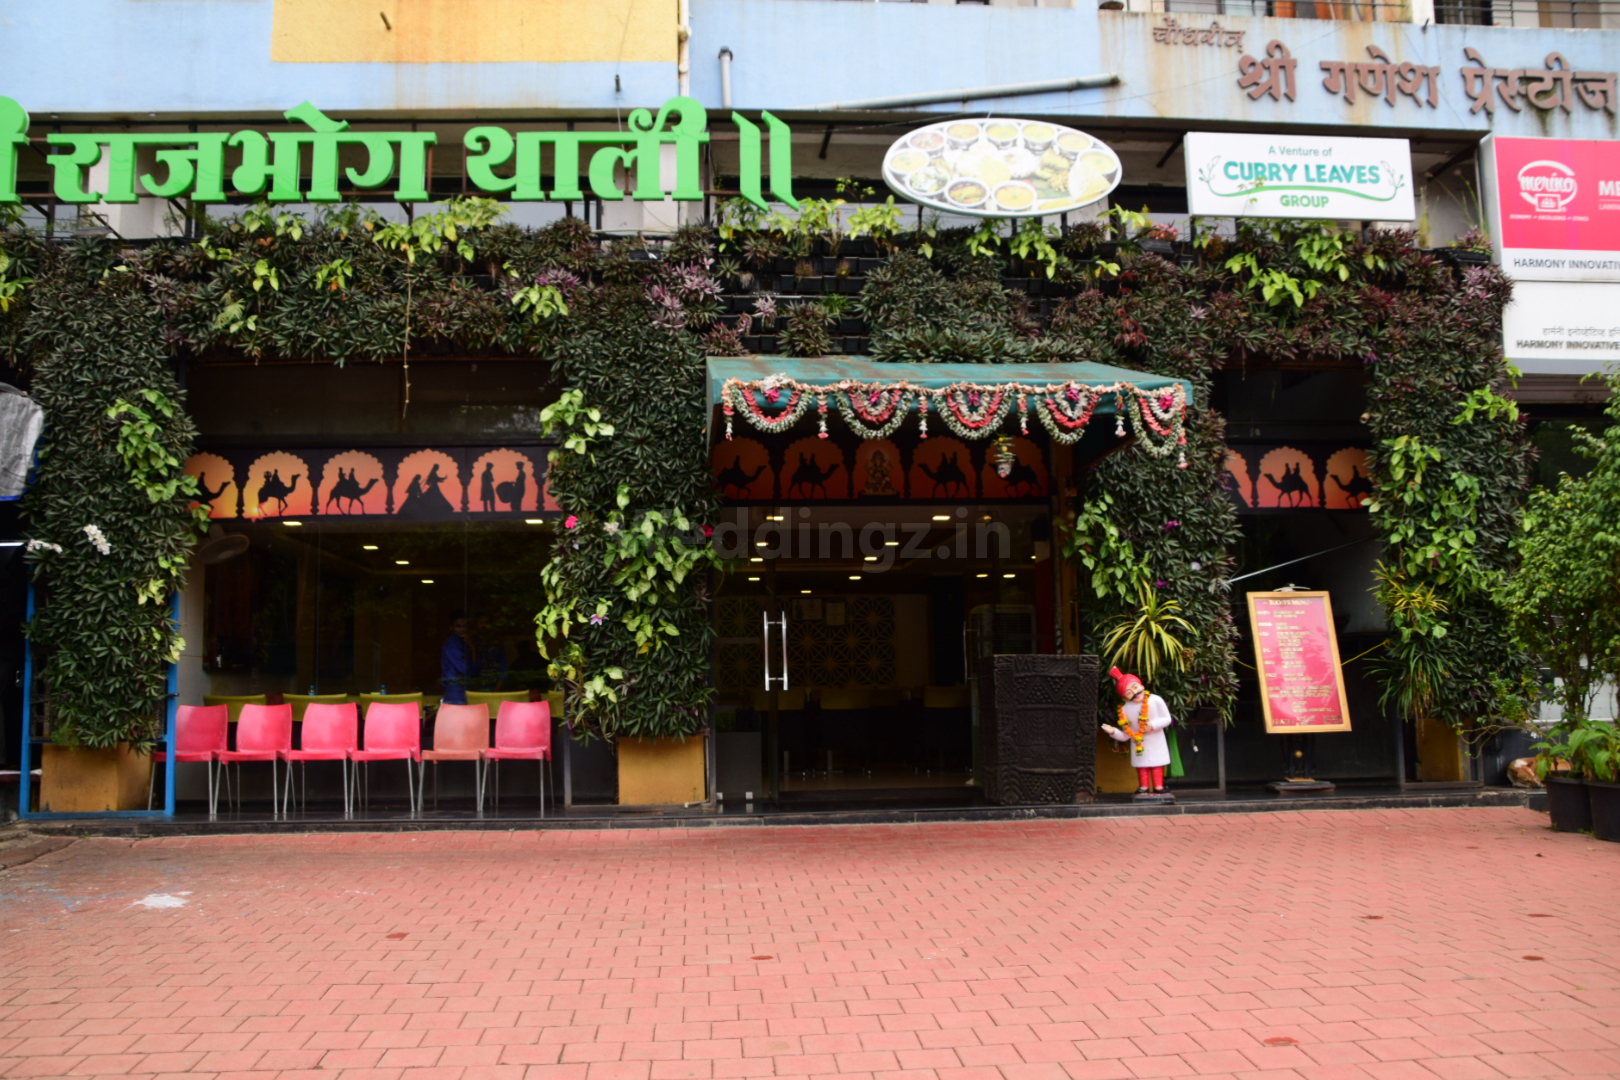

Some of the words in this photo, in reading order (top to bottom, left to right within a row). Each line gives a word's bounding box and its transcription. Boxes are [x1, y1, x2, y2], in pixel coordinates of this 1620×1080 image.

[1237, 39, 1297, 102] श्री
[1320, 45, 1440, 109] गणेश
[1461, 46, 1618, 115] प्रेस्टीज
[46, 100, 438, 203] राजभोग
[463, 95, 710, 201] थाली
[1268, 146, 1276, 155] A
[1279, 146, 1320, 156] Venture
[1322, 147, 1333, 156] of
[1223, 161, 1298, 182] CURRY
[1304, 164, 1381, 184] LEAVES
[1519, 172, 1577, 193] merino
[1280, 194, 1329, 208] GROUP
[1513, 258, 1566, 269] HARMONY
[1515, 339, 1564, 350] HARMONY
[1565, 340, 1620, 351] INNOVATIVE
